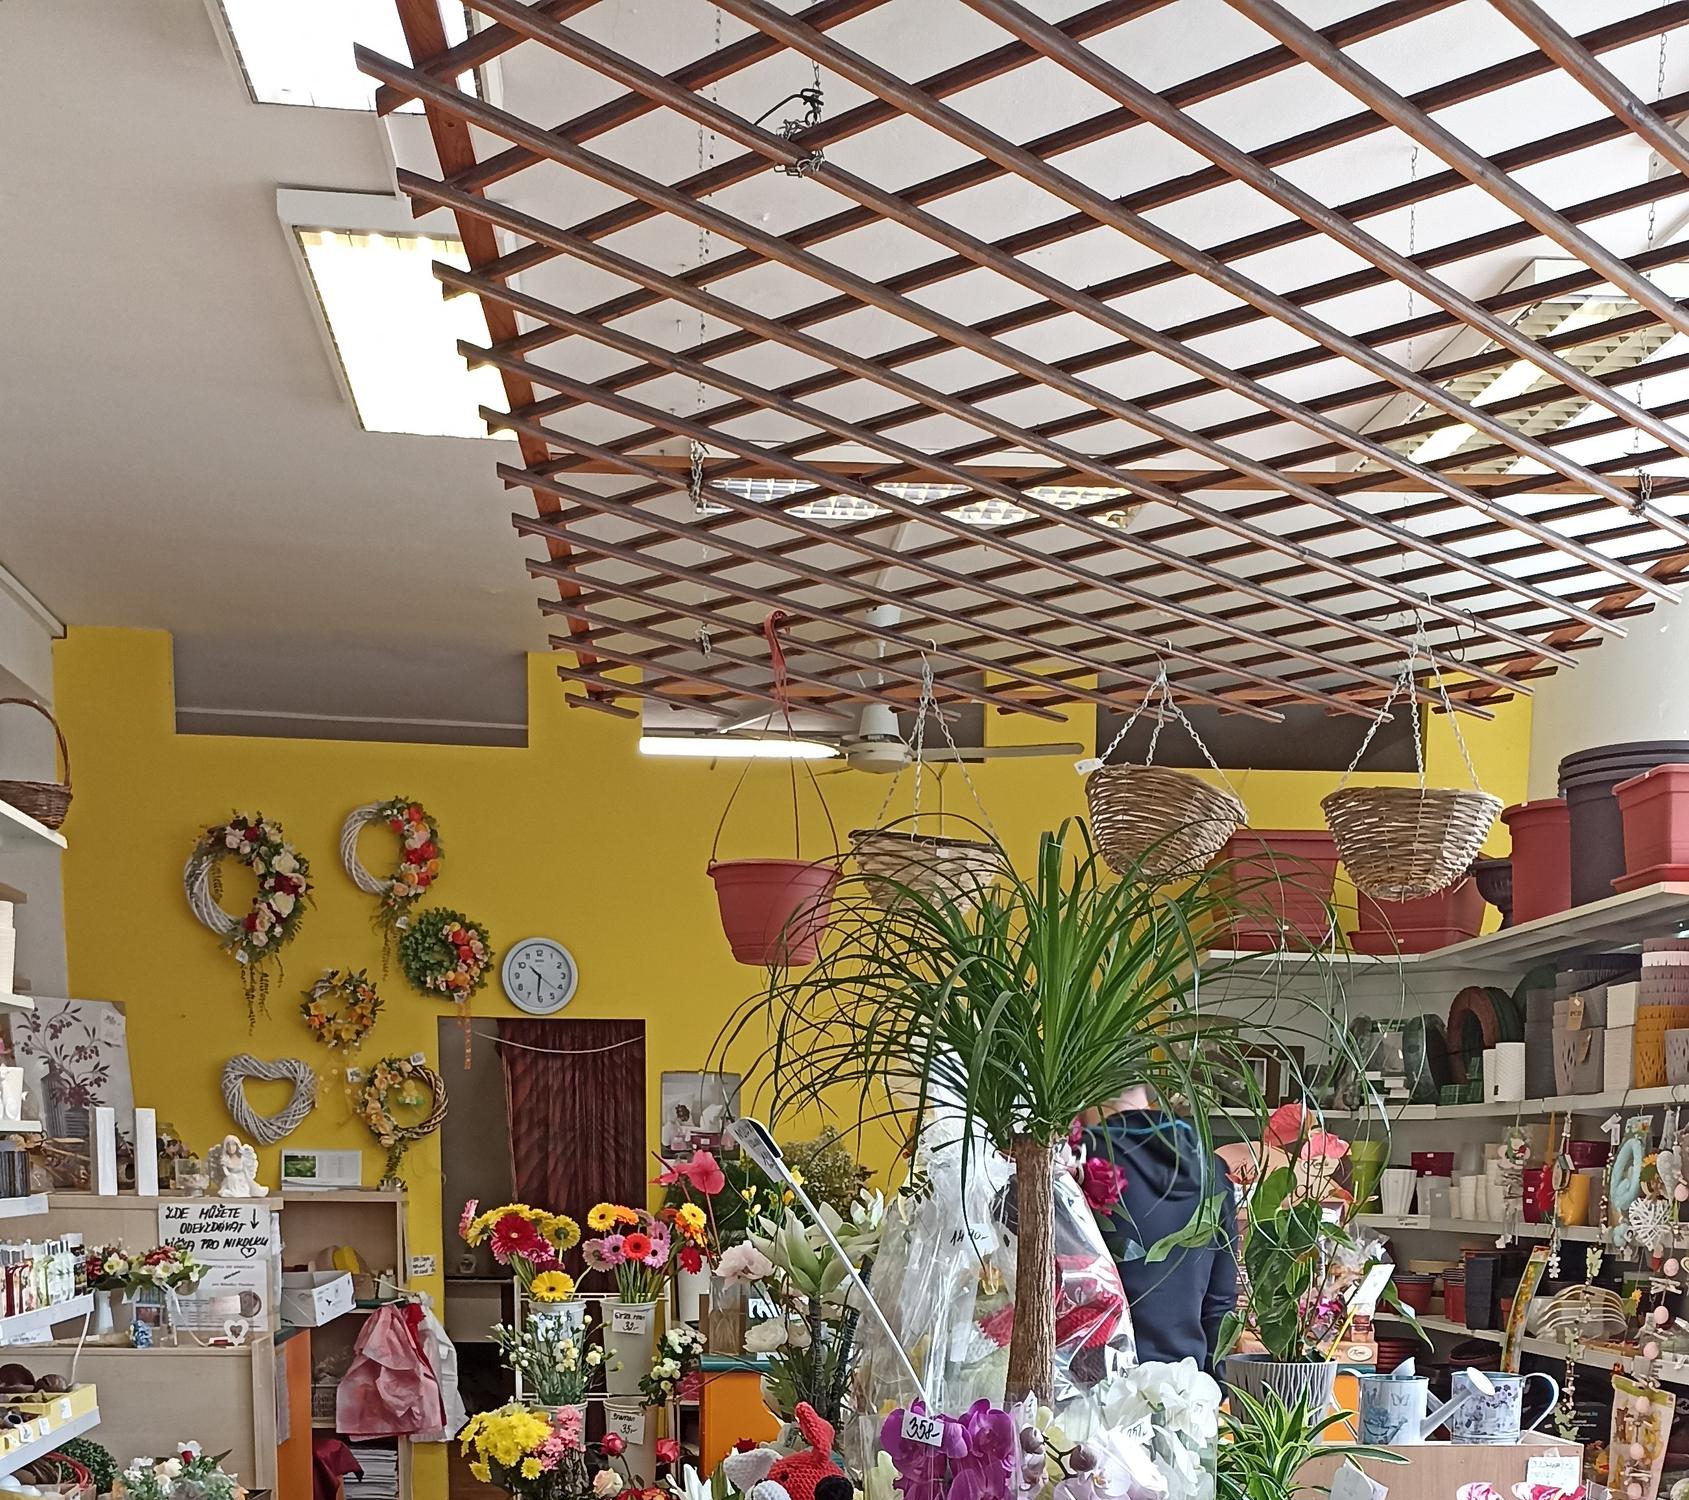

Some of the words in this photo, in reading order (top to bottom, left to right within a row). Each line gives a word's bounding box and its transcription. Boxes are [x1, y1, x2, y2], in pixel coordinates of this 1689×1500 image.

[536, 949, 544, 957] 12
[518, 961, 527, 969] 10
[556, 961, 562, 969] 2
[560, 972, 566, 980] 3
[549, 992, 556, 1000] 5
[165, 1206, 190, 1219] ZDE
[200, 1239, 220, 1250] PRO
